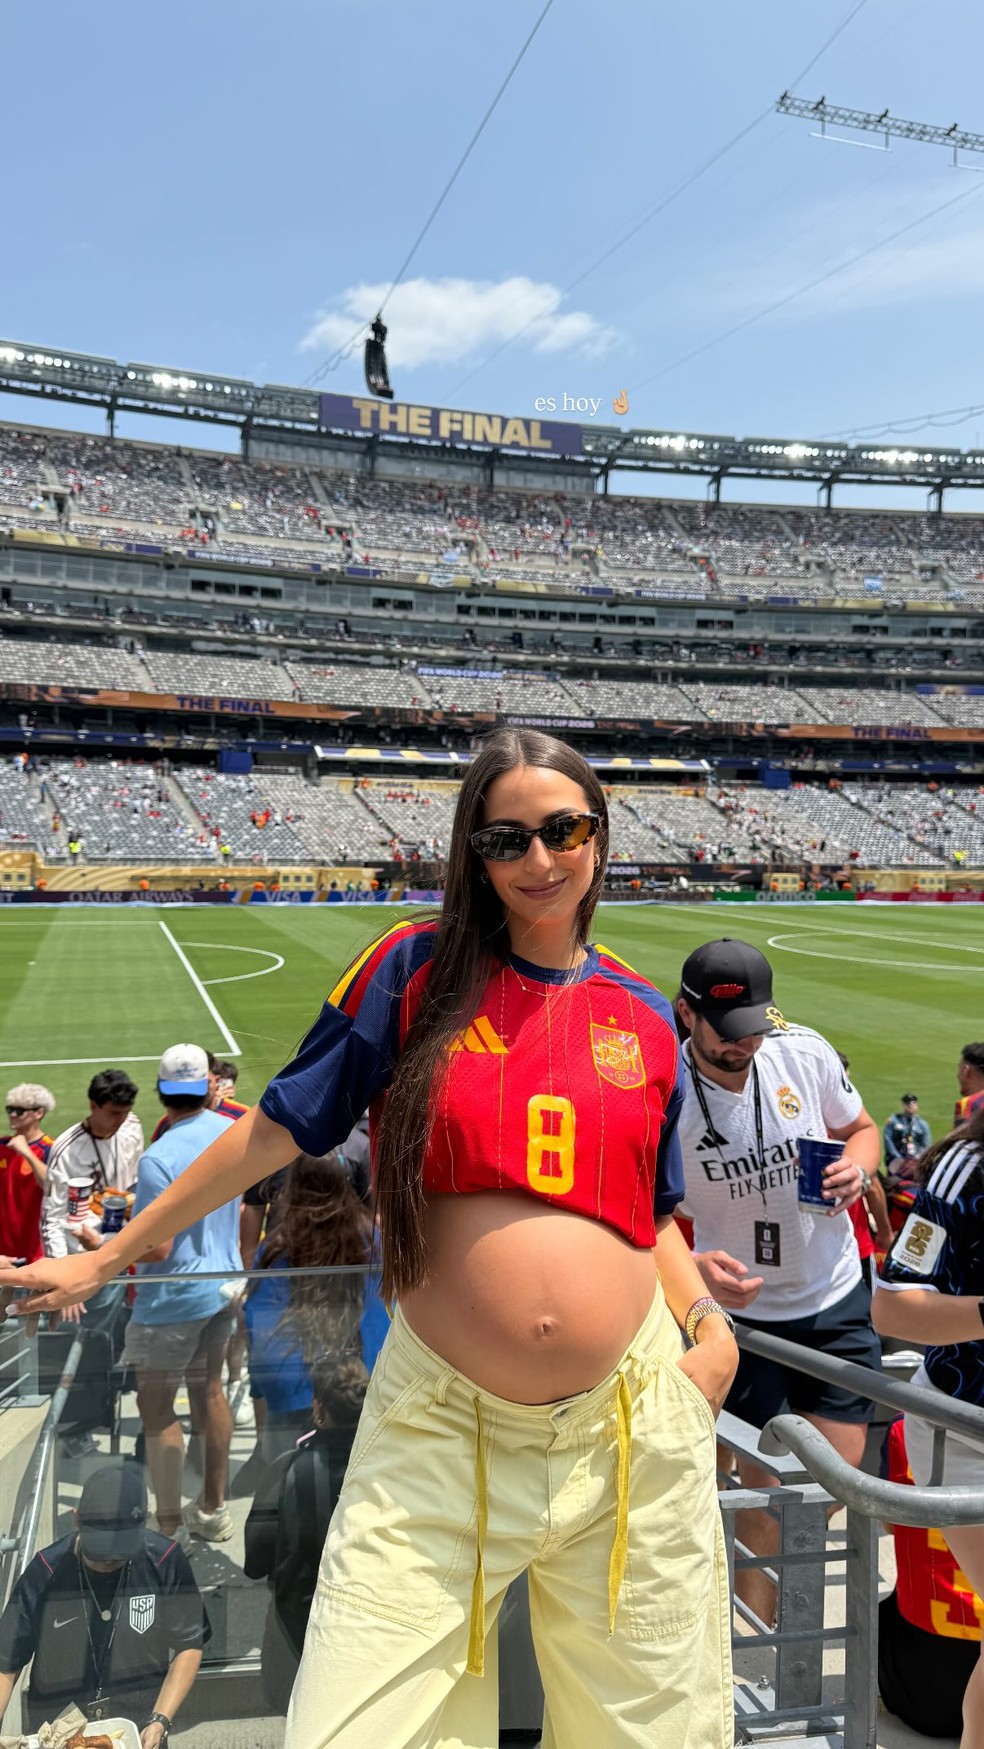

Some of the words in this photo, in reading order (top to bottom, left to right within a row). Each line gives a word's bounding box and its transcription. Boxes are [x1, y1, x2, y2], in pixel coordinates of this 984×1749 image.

[352, 399, 432, 436] THE
[439, 409, 553, 449] FINAL
[176, 696, 214, 710] THE
[219, 699, 276, 714] FINAL
[69, 892, 123, 903] QATAR
[130, 892, 195, 903] AIRWAYS
[264, 891, 302, 902] VISA
[341, 892, 377, 902] VISA
[755, 891, 816, 902] aramco
[527, 1094, 576, 1195] 8
[729, 1178, 752, 1200] FLY
[132, 1597, 153, 1612] USA
